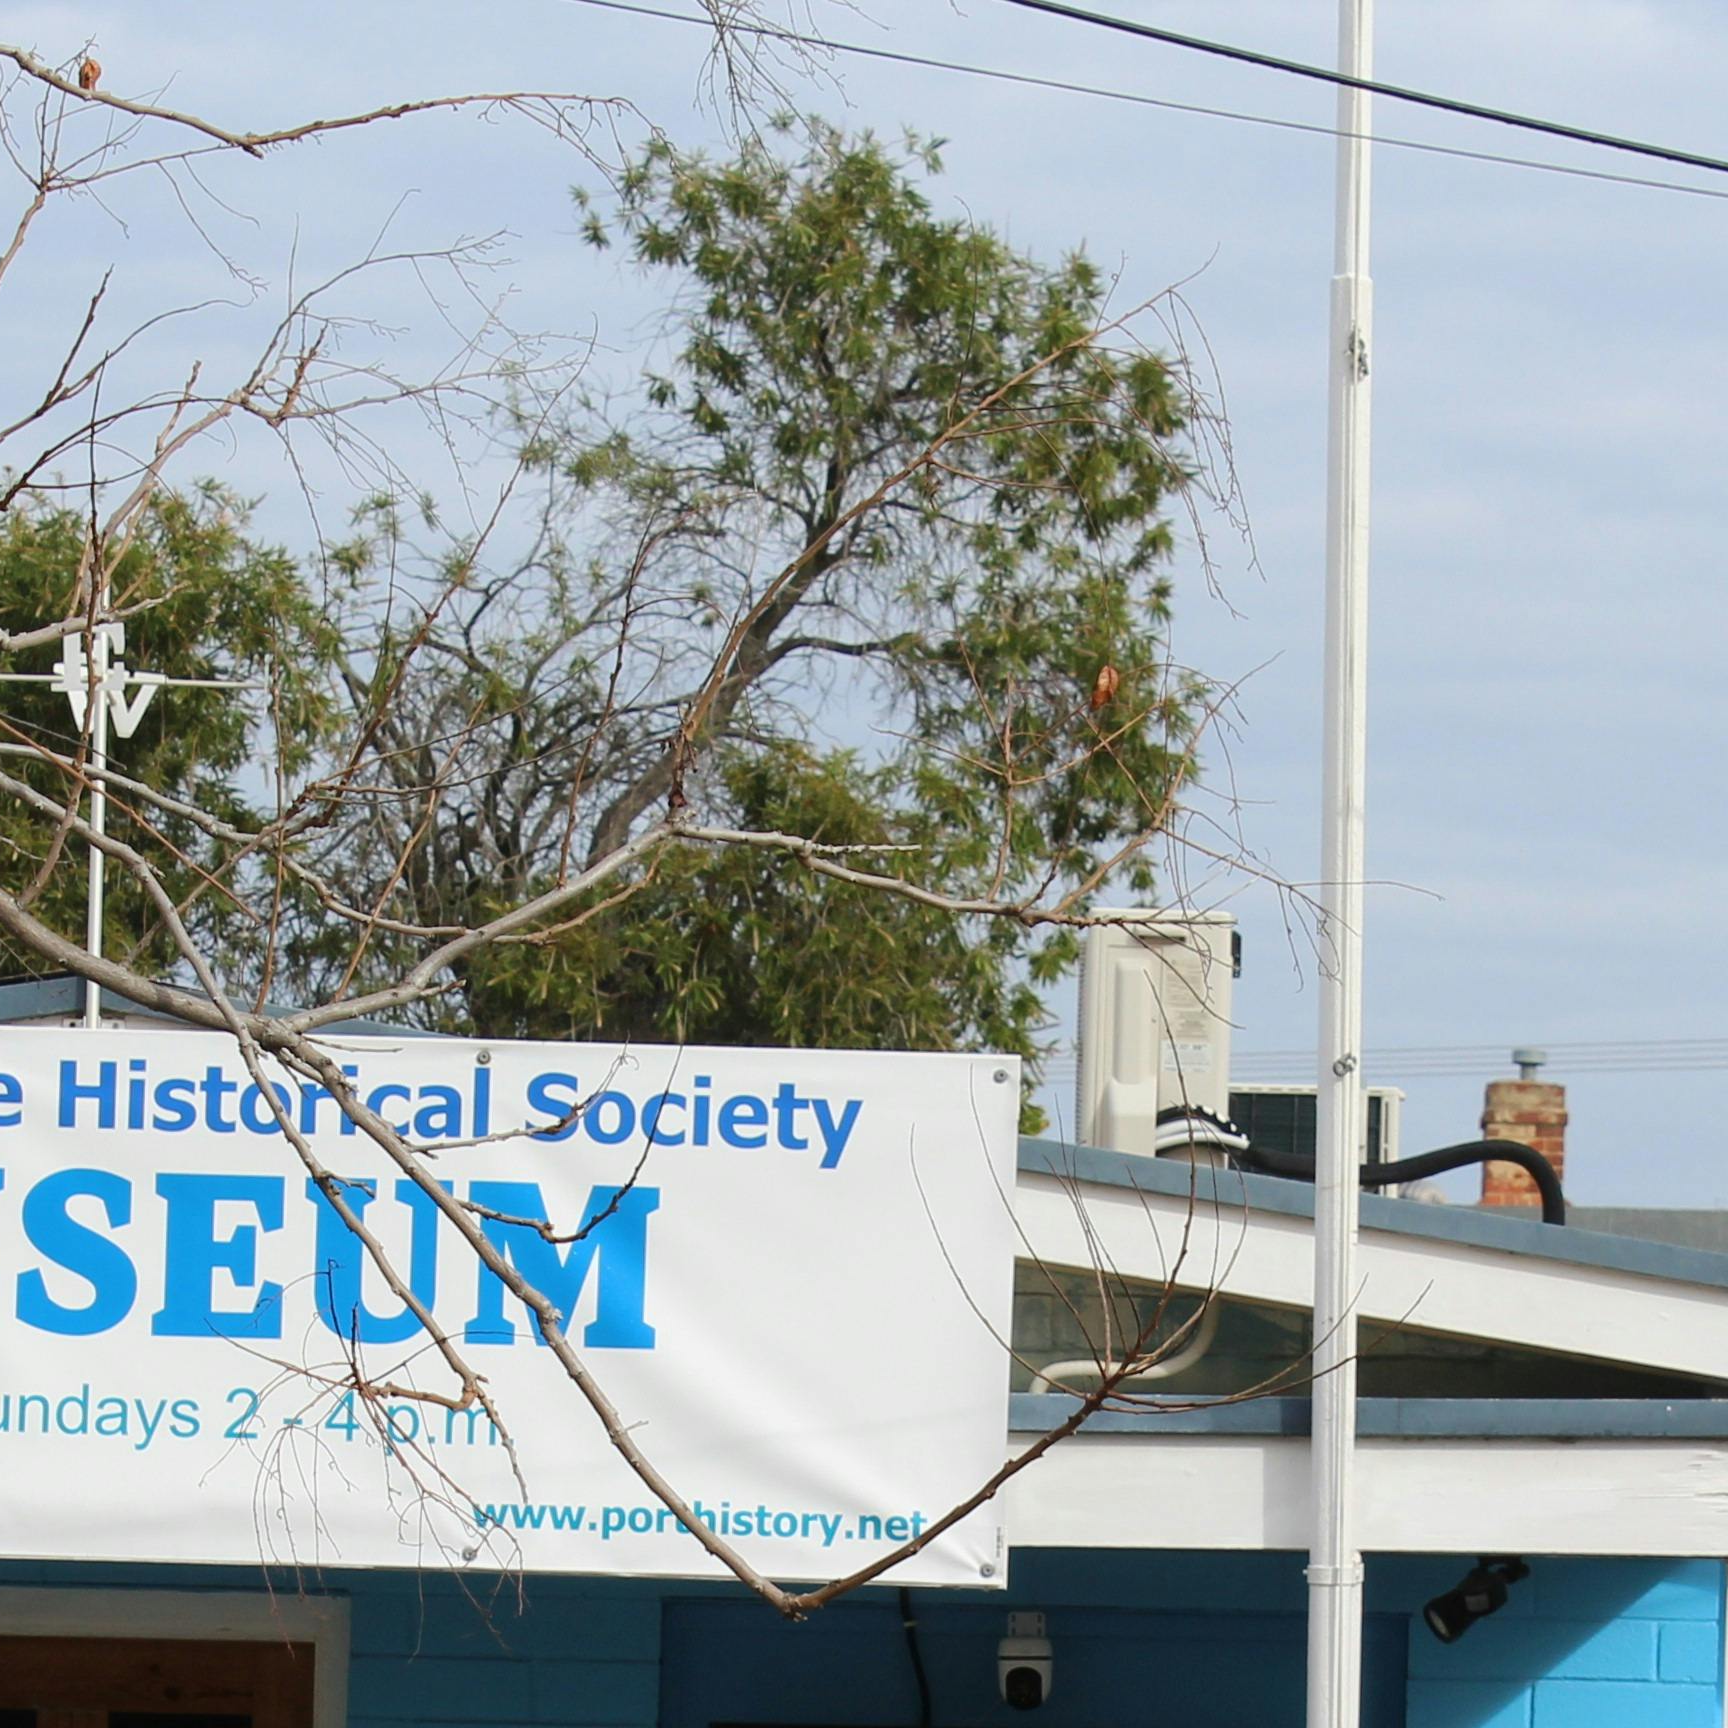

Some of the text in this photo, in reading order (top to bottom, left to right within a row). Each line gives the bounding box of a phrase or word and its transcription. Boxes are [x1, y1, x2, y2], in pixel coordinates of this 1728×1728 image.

[58, 1058, 491, 1139] Historical
[528, 1072, 862, 1169] Society
[223, 1387, 260, 1440] 2
[324, 1389, 361, 1442] 4
[385, 1400, 515, 1457] p.m.
